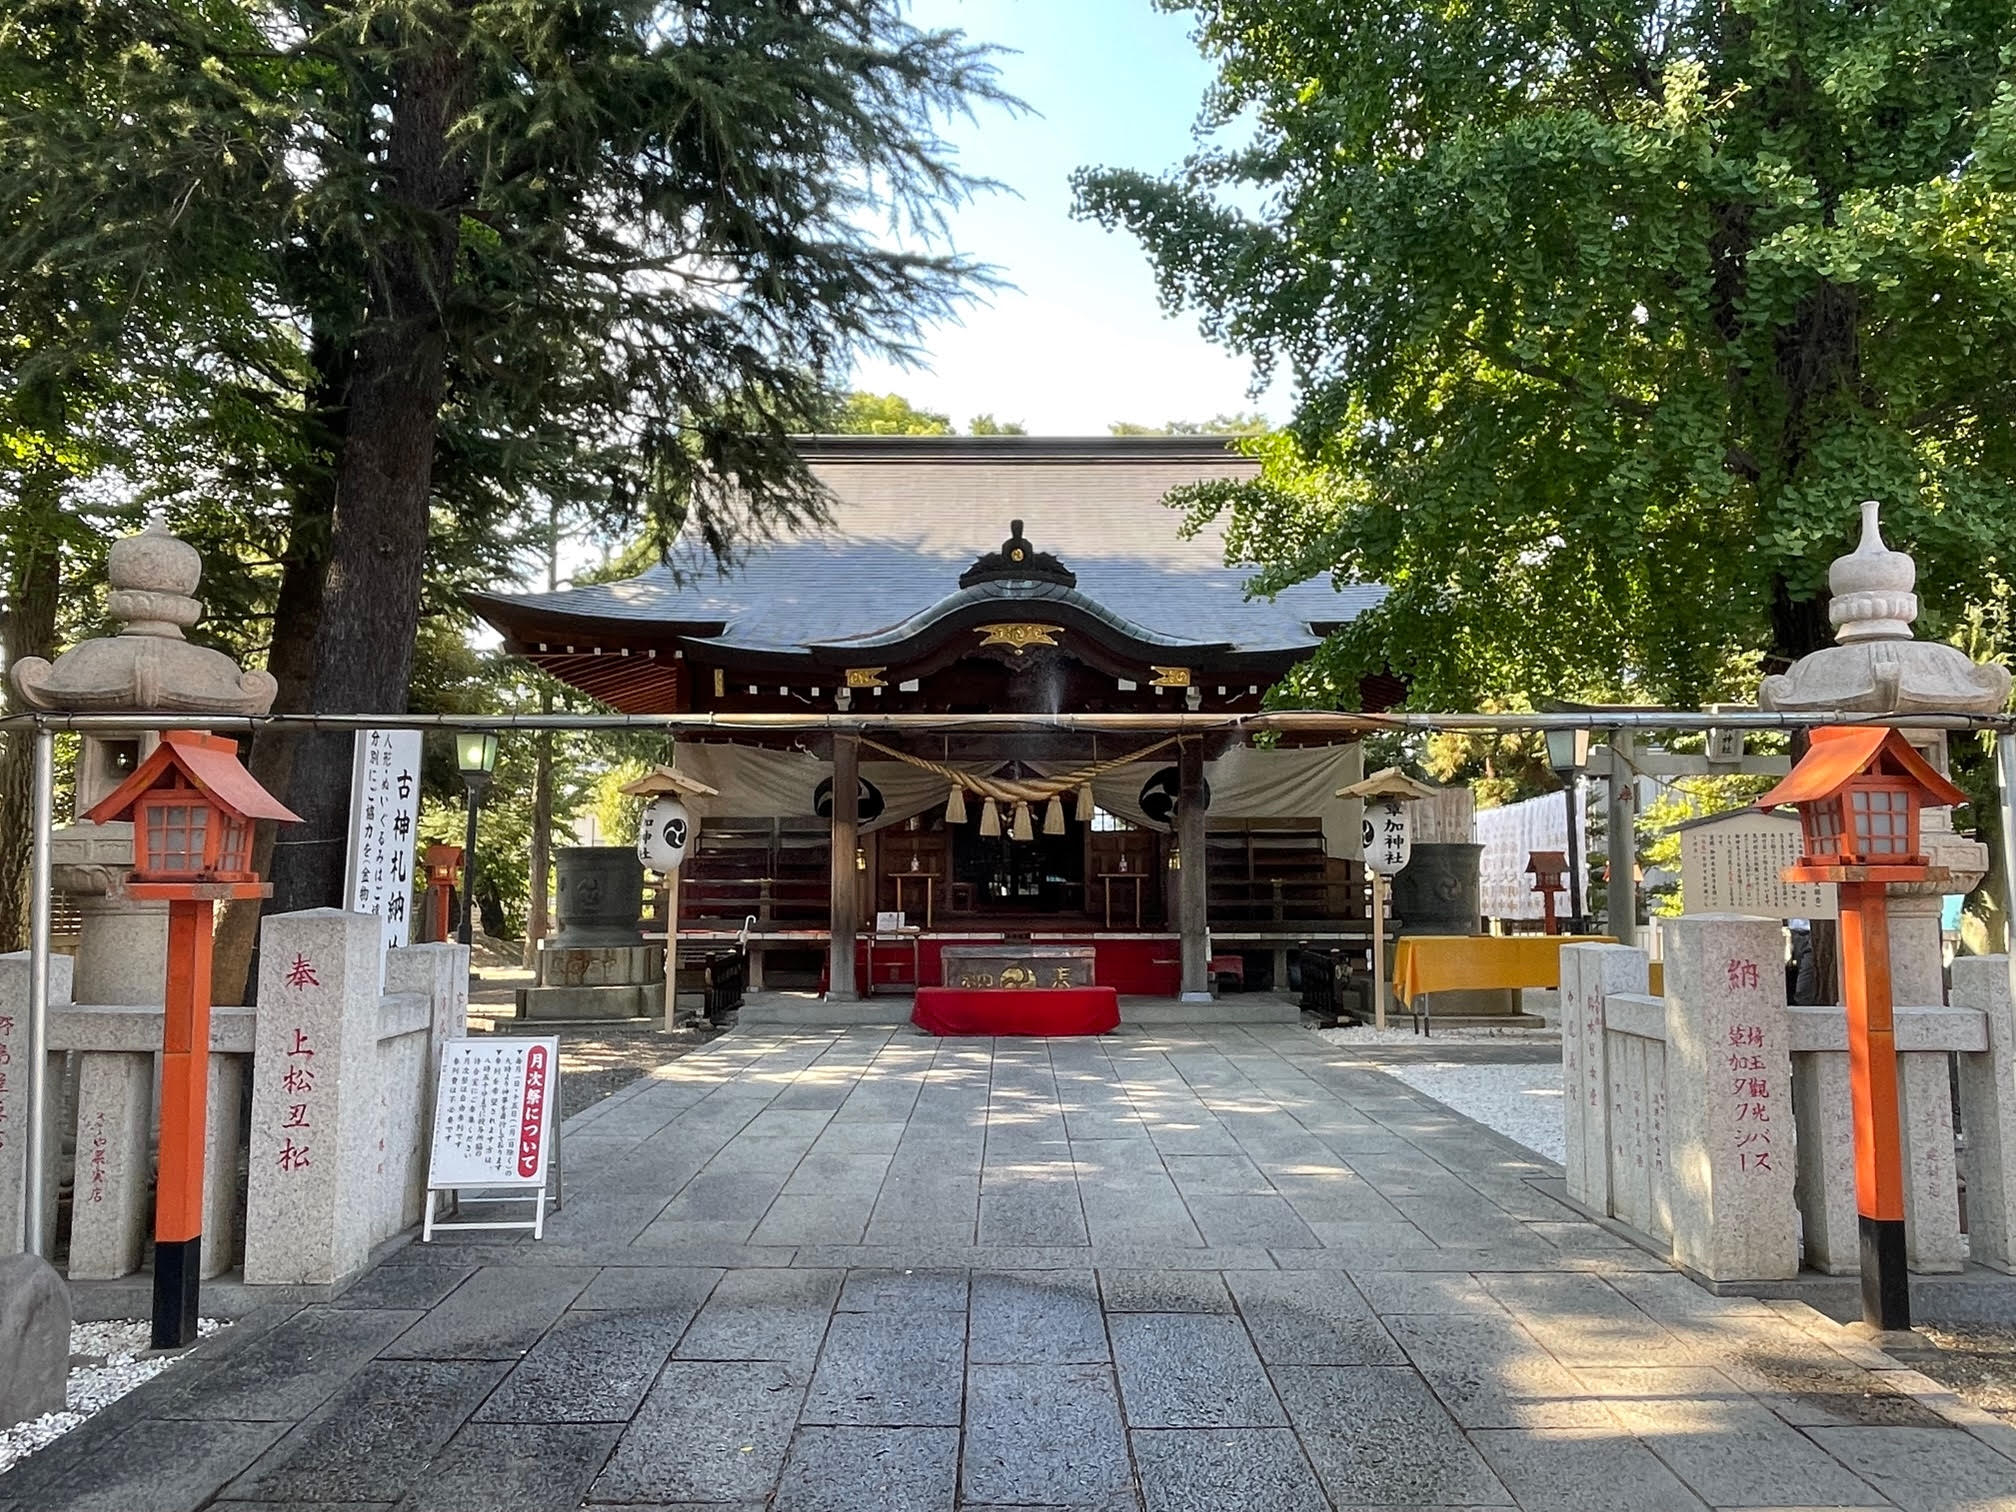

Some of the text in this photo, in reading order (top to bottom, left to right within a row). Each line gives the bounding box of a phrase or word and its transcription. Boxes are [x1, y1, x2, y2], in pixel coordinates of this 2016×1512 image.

[285, 952, 320, 991] 奉
[1728, 959, 1760, 990] 納
[521, 1053, 543, 1169] 月次祭について
[1728, 1024, 1750, 1172] 草加タクシー
